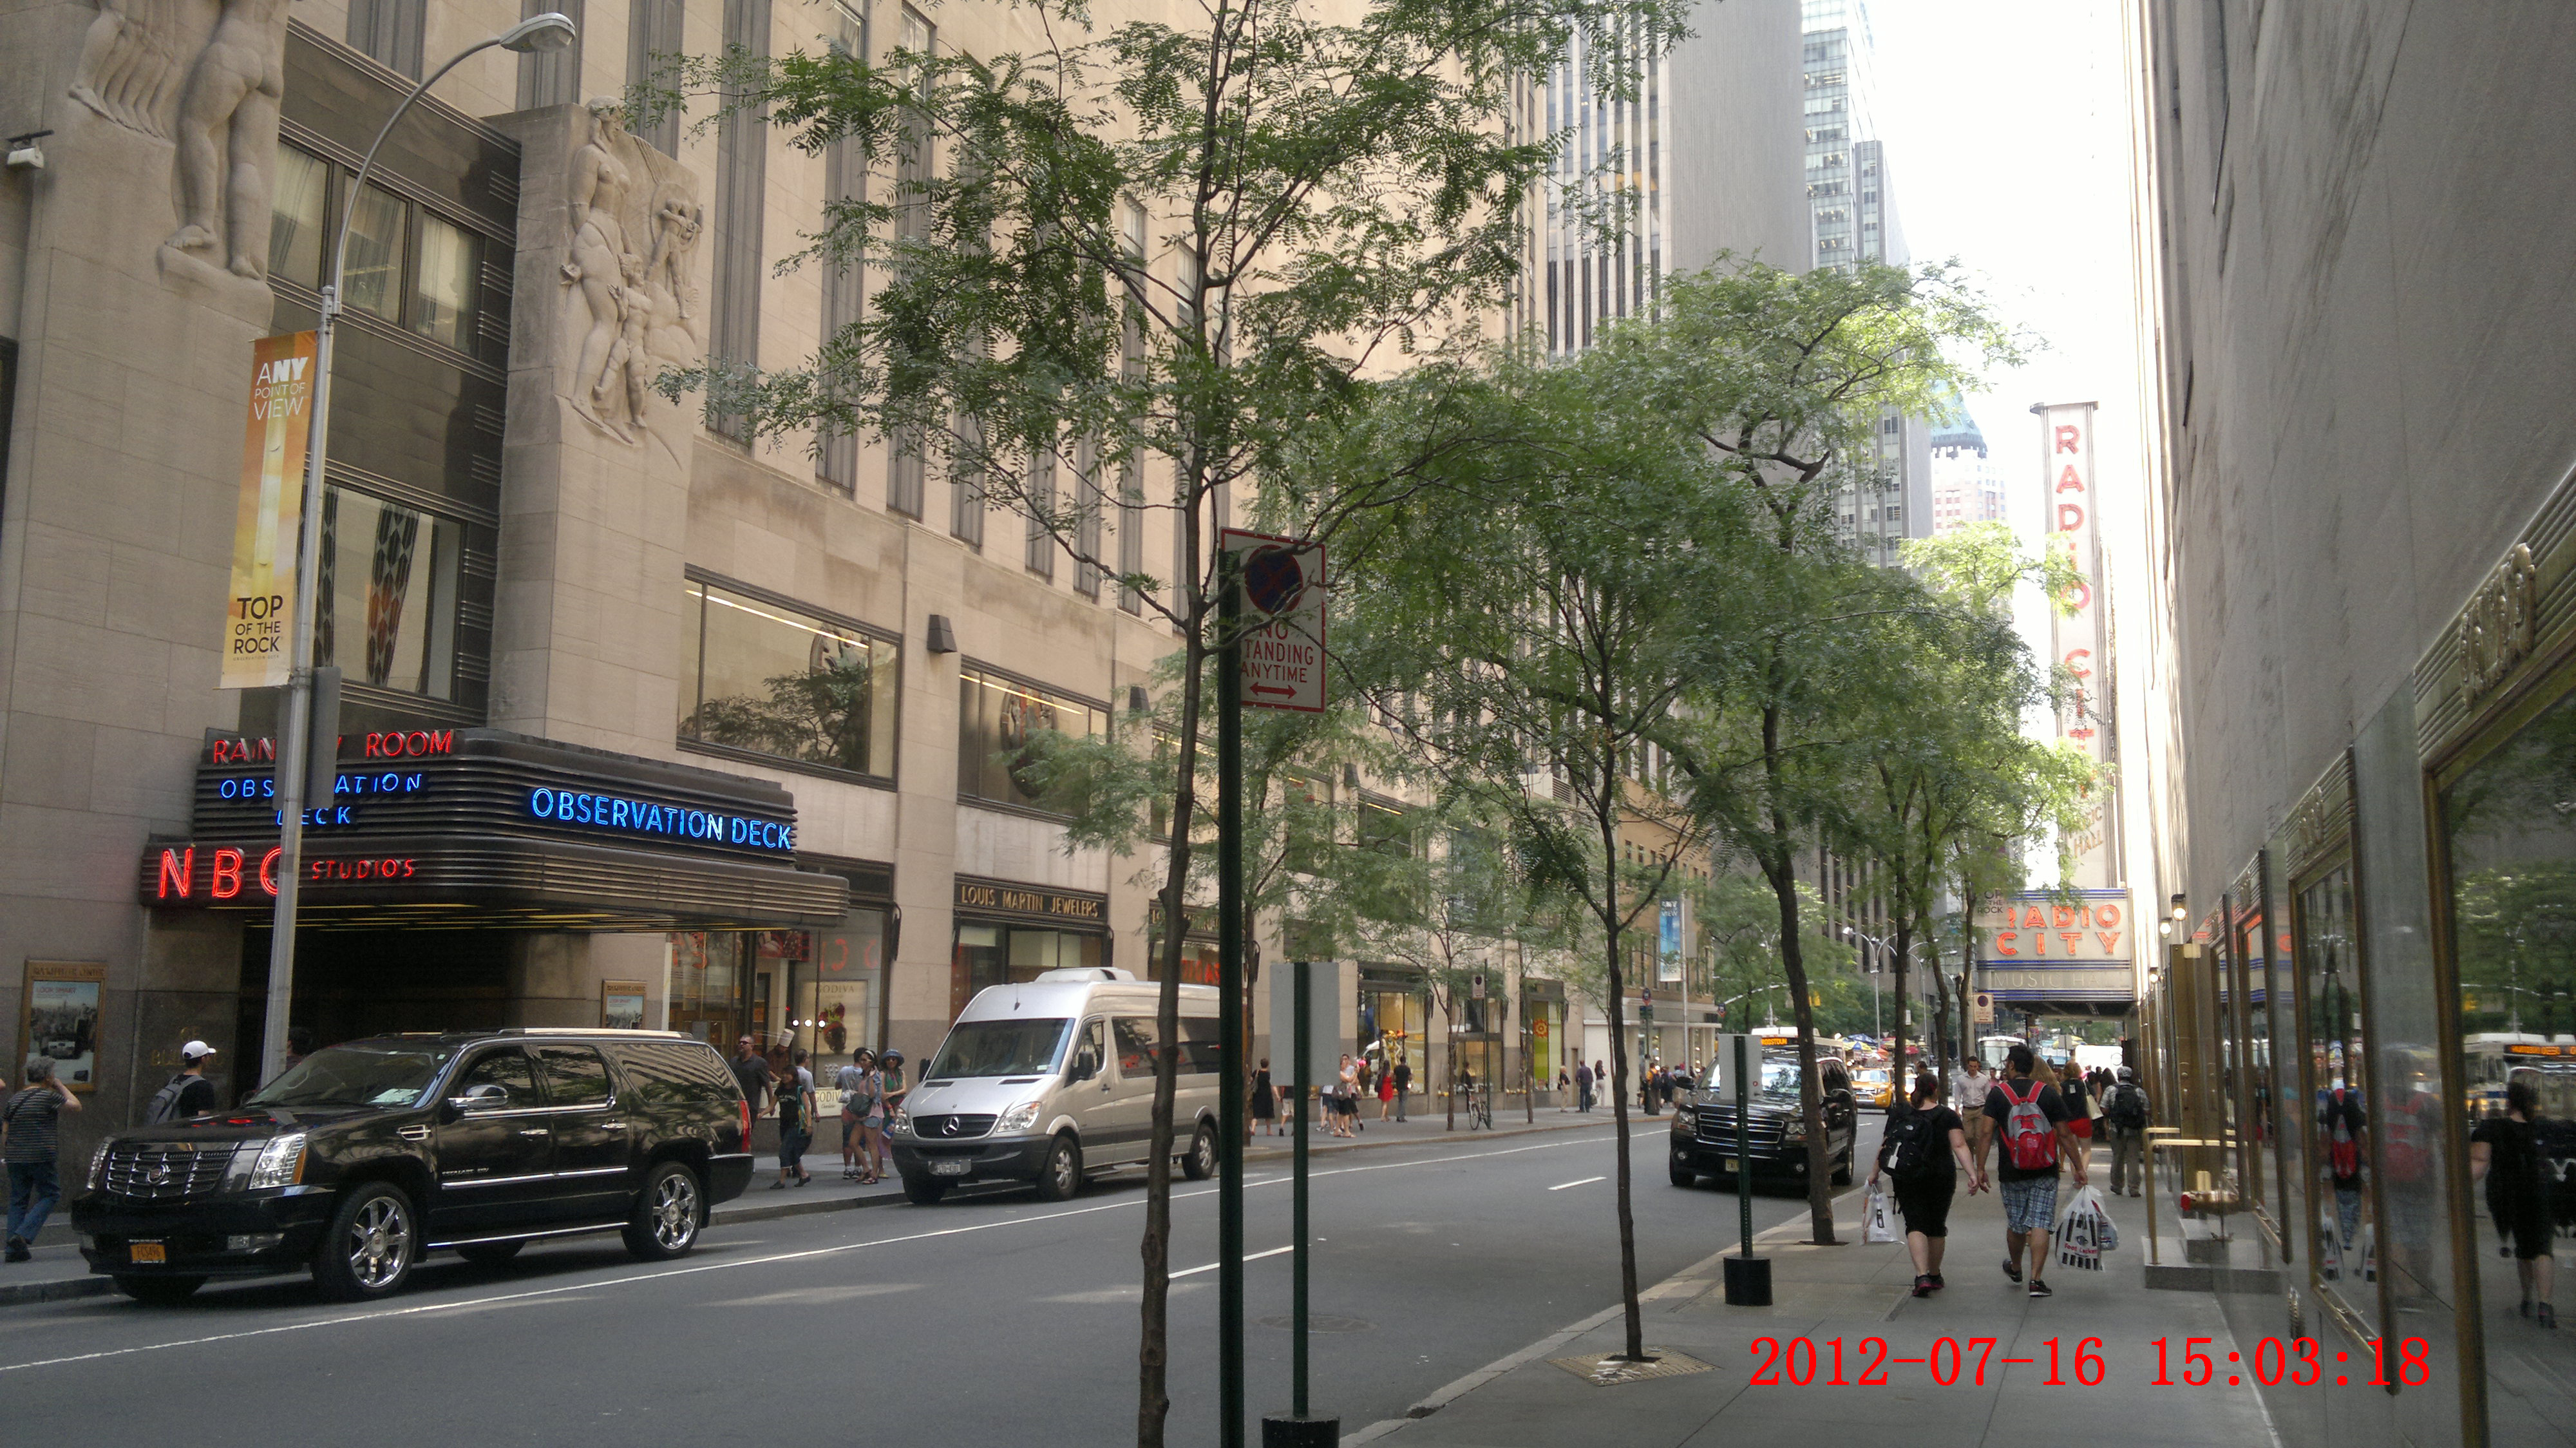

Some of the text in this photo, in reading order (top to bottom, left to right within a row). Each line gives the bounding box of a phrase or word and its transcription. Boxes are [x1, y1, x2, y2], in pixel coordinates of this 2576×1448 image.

[256, 356, 308, 385] ANY
[254, 382, 305, 399] POINT OF
[254, 396, 303, 420] VIEW
[2056, 424, 2090, 609] RADIO
[236, 595, 283, 620] TOP
[235, 621, 281, 635] OF THE
[233, 636, 280, 654] ROCK
[1244, 638, 1314, 665] TANDING
[1240, 661, 1308, 683] ANYTIME
[214, 730, 452, 764] RAIN ROOM
[220, 772, 422, 799] OBSATION
[532, 787, 791, 850] OBSERVATION DECK
[312, 859, 413, 880] STUDIOS
[961, 885, 1099, 918] LOUIS MARTIN JEWELERS
[1996, 931, 2122, 956] CITY
[1994, 971, 2061, 988] MUSIC
